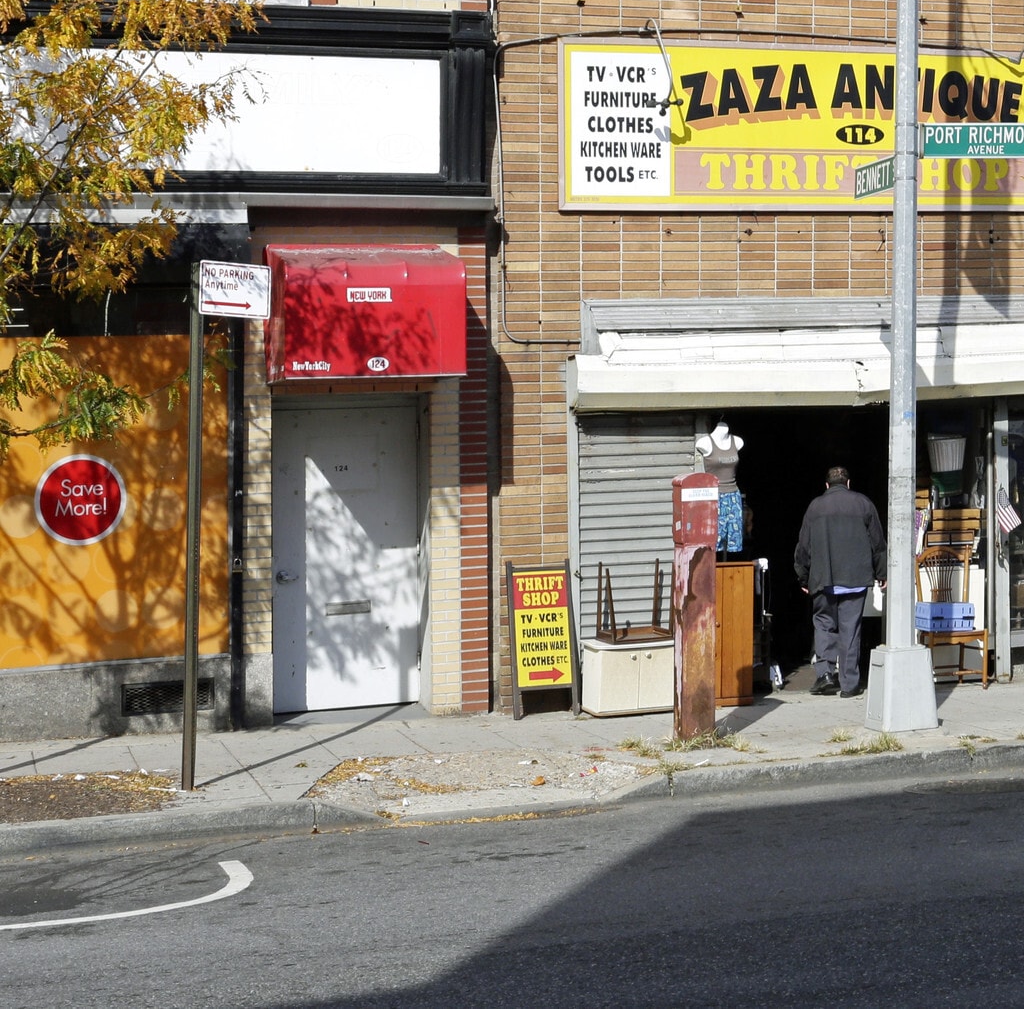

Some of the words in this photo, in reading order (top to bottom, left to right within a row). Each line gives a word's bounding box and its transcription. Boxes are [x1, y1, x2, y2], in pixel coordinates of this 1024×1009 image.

[587, 66, 606, 83] TV
[680, 63, 820, 125] ZAZA
[831, 63, 1023, 124] ANIQUE
[588, 116, 653, 134] CLOTHES
[845, 127, 877, 143] 114
[925, 126, 962, 144] PORT
[580, 142, 628, 159] KITCHEN
[631, 142, 661, 159] WARE
[967, 145, 1005, 155] AVENUE
[585, 166, 634, 183] TOOLS
[639, 169, 659, 180] ETC.
[856, 161, 891, 196] BENNETT
[918, 155, 1009, 191] HOP
[204, 267, 216, 278] NO
[219, 268, 254, 281] PARKING
[204, 279, 239, 291] Anytime
[350, 291, 366, 301] NEW
[368, 291, 387, 301] YORK
[371, 359, 386, 369] 124
[60, 478, 104, 497] Save
[55, 497, 107, 517] More!
[516, 576, 563, 591] THRIFT
[522, 591, 559, 606] SHOP
[521, 614, 532, 624] TV
[522, 627, 564, 639] FURNITURE
[520, 642, 548, 653] KITCHEN
[549, 640, 567, 651] WARE
[522, 656, 555, 667] CLOTHES
